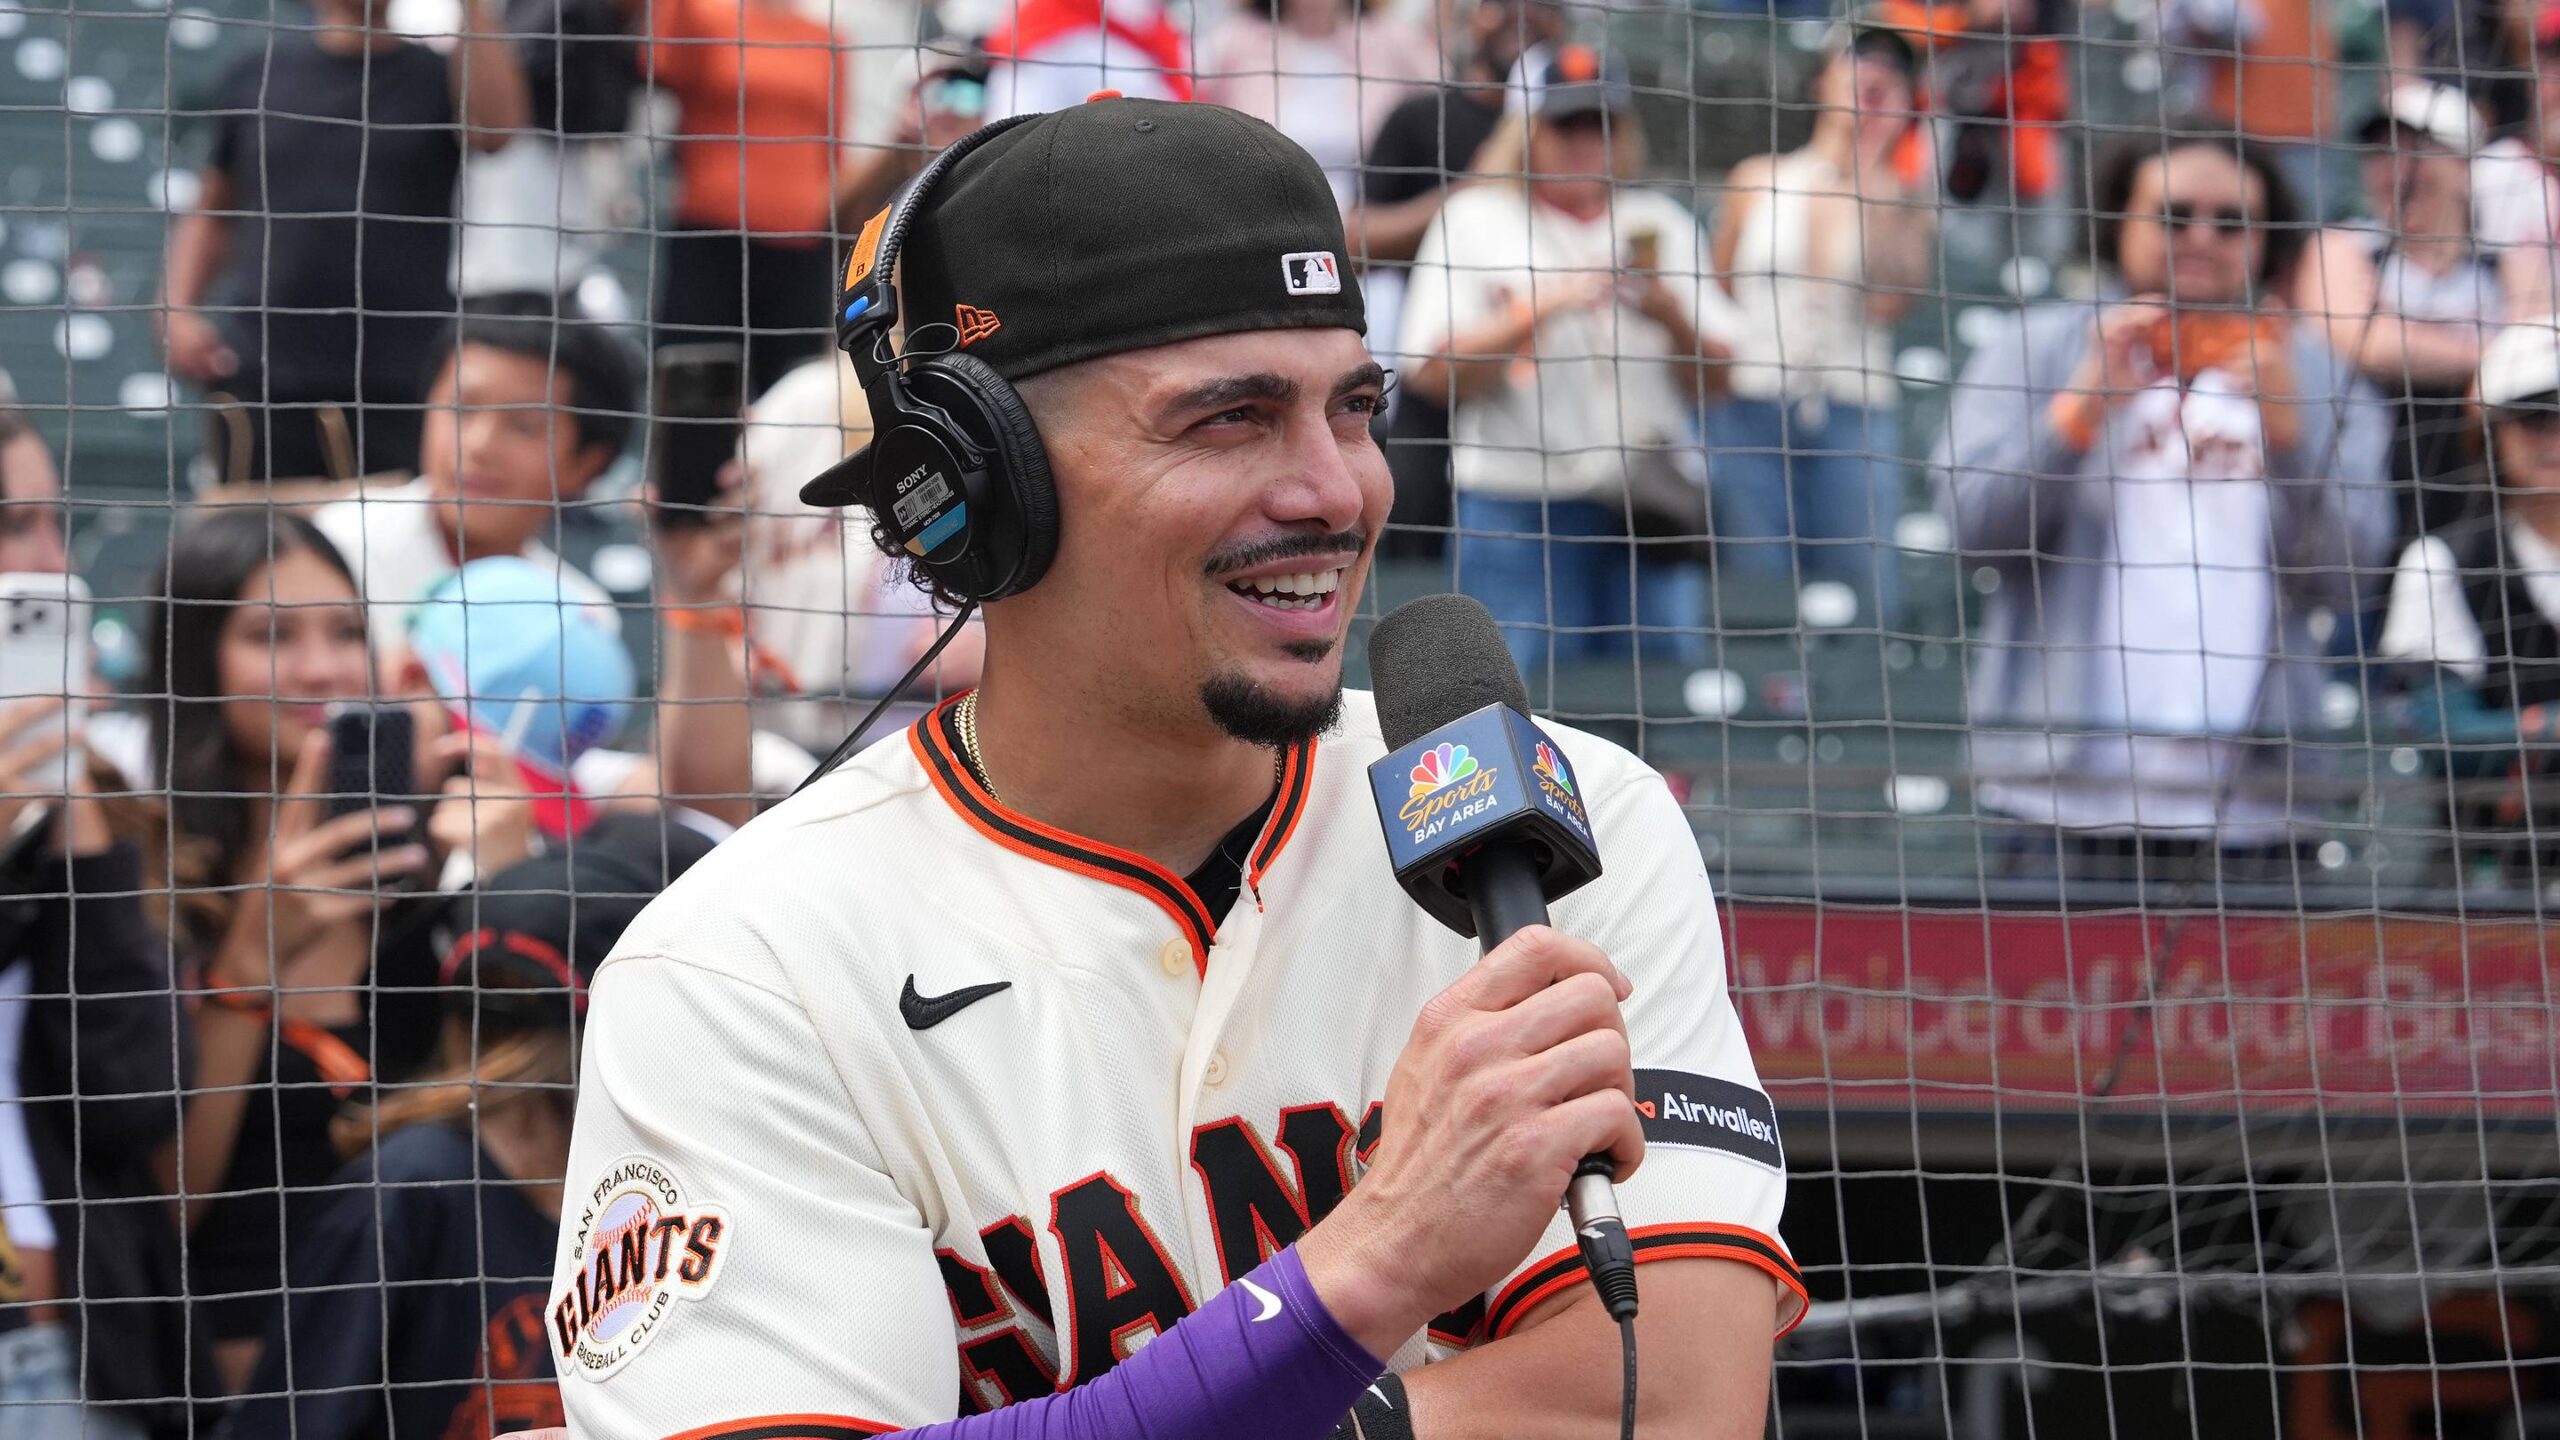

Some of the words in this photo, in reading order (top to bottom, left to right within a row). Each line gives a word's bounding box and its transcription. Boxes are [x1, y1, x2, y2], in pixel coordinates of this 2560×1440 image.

[897, 464, 927, 494] SONY
[1399, 767, 1497, 832] Sports
[1415, 816, 1446, 844] BAY
[1450, 794, 1498, 825] AREA
[1532, 764, 1585, 821] Sports
[1545, 793, 1564, 815] BAY
[1567, 813, 1590, 839] AREA
[1741, 952, 2006, 1054] Voice
[2020, 955, 2118, 1056] of
[2134, 957, 2346, 1057] Your
[1663, 1092, 1775, 1145] Airwallex
[574, 1208, 594, 1260] SAN
[593, 1163, 678, 1207] FRANCISCO
[555, 1214, 725, 1358] GIANTS
[576, 1341, 627, 1370] BASEBALL
[630, 1291, 670, 1345] CLUB
